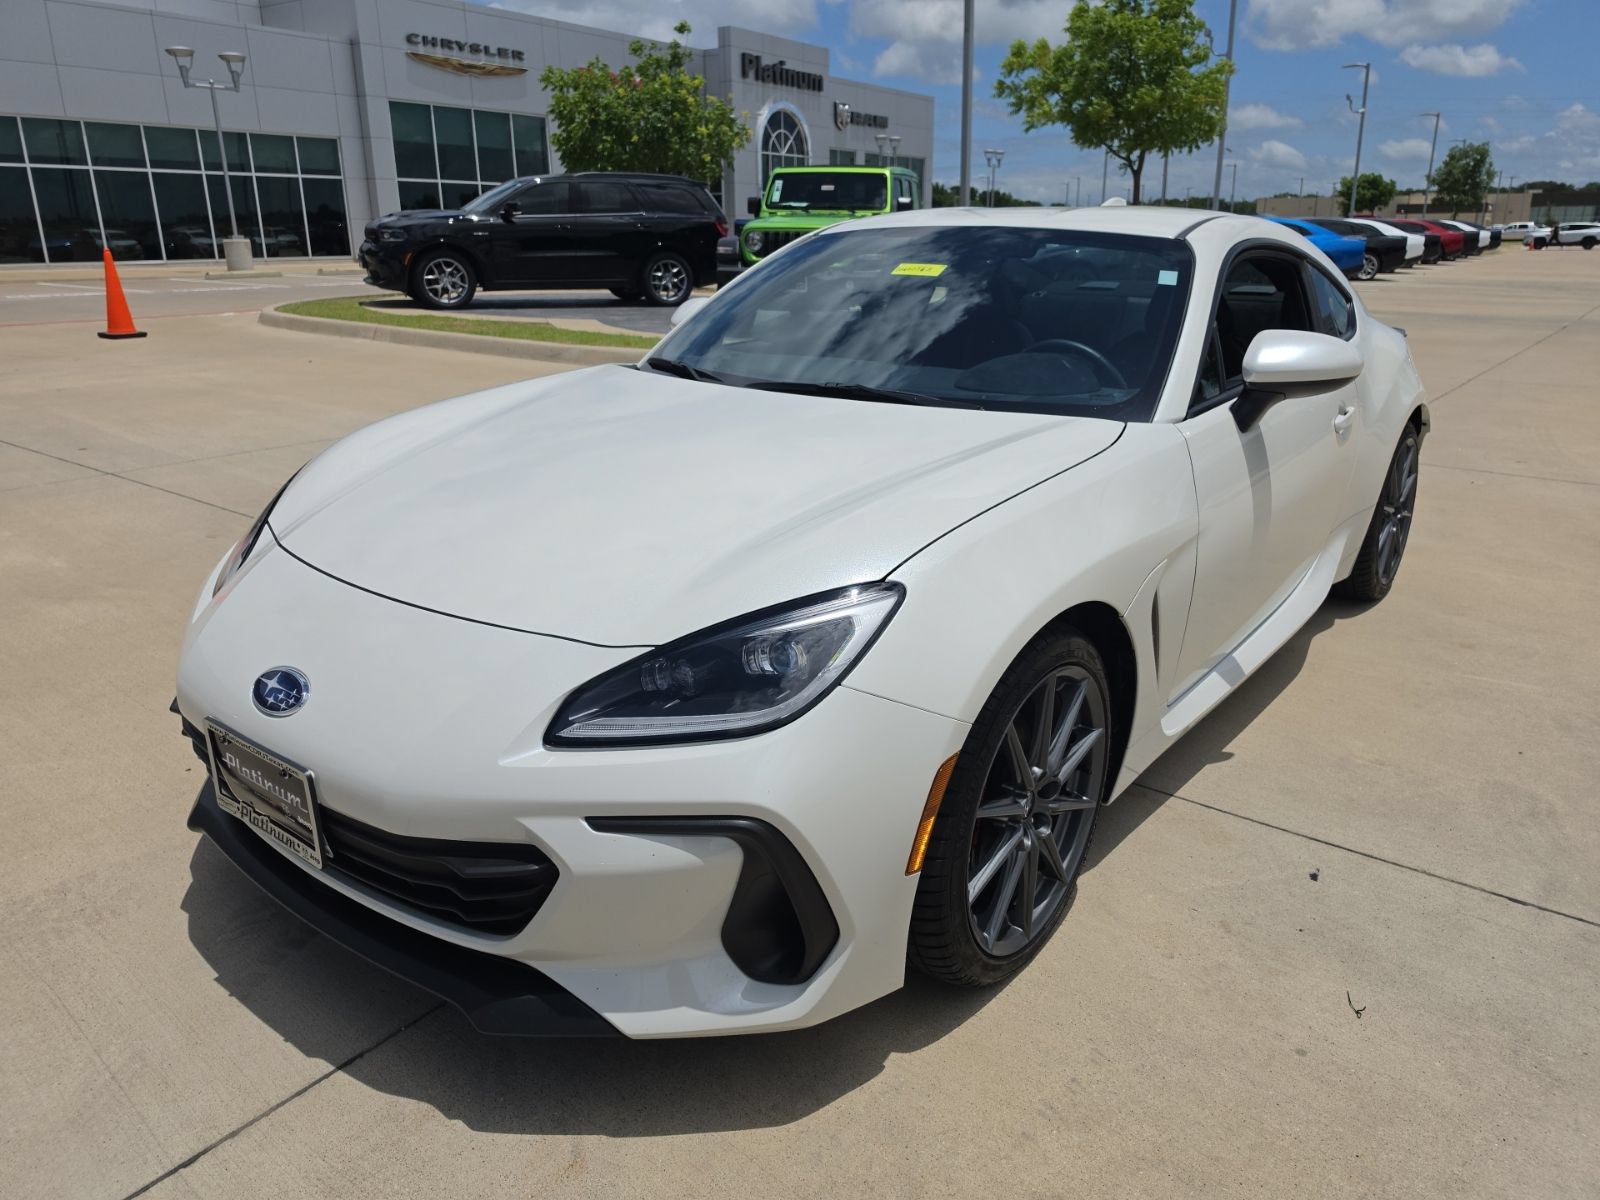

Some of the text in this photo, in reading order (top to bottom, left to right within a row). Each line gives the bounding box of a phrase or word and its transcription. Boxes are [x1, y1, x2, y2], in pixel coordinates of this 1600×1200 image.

[406, 33, 525, 61] CHRYSLER
[741, 52, 824, 92] Platinum
[222, 751, 309, 813] Platinum
[240, 802, 300, 853] Platinum
